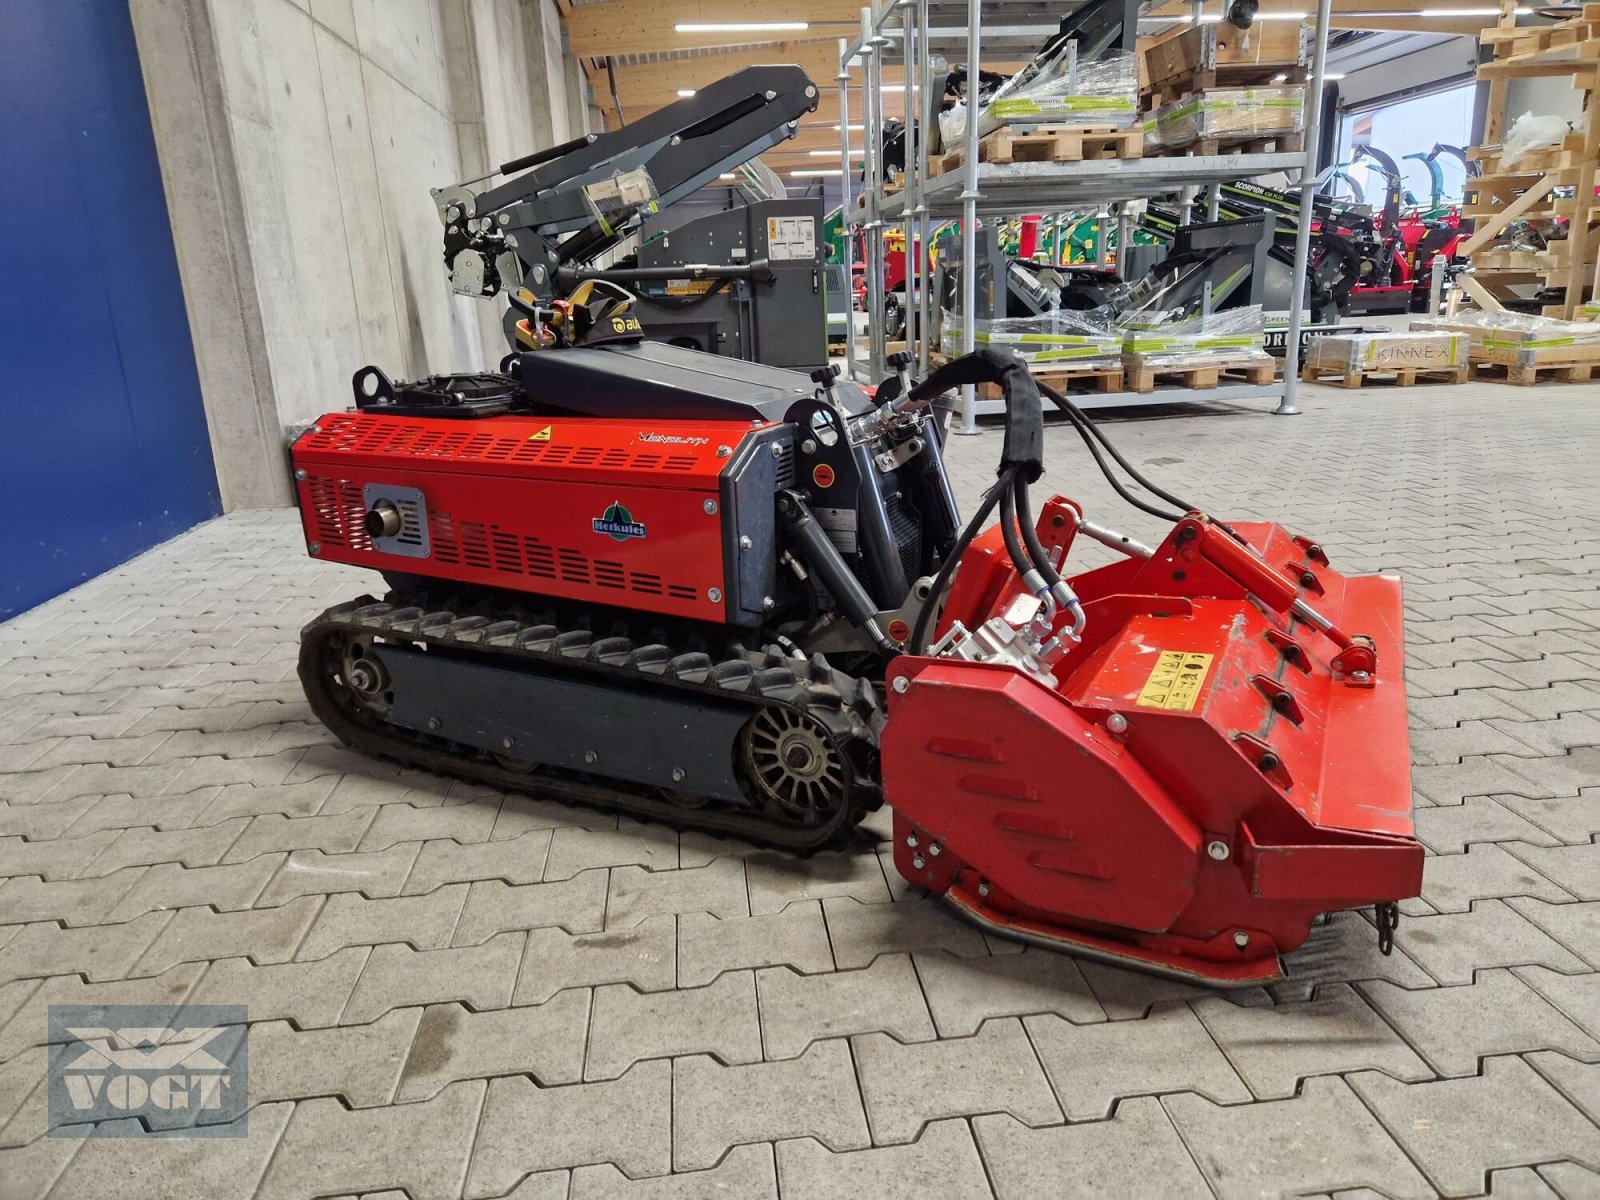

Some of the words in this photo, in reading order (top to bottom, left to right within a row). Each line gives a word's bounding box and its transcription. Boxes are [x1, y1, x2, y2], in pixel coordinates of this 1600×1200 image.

[1234, 181, 1265, 195] SCORPION
[1377, 344, 1449, 361] KINNEX
[594, 520, 645, 535] Herkules
